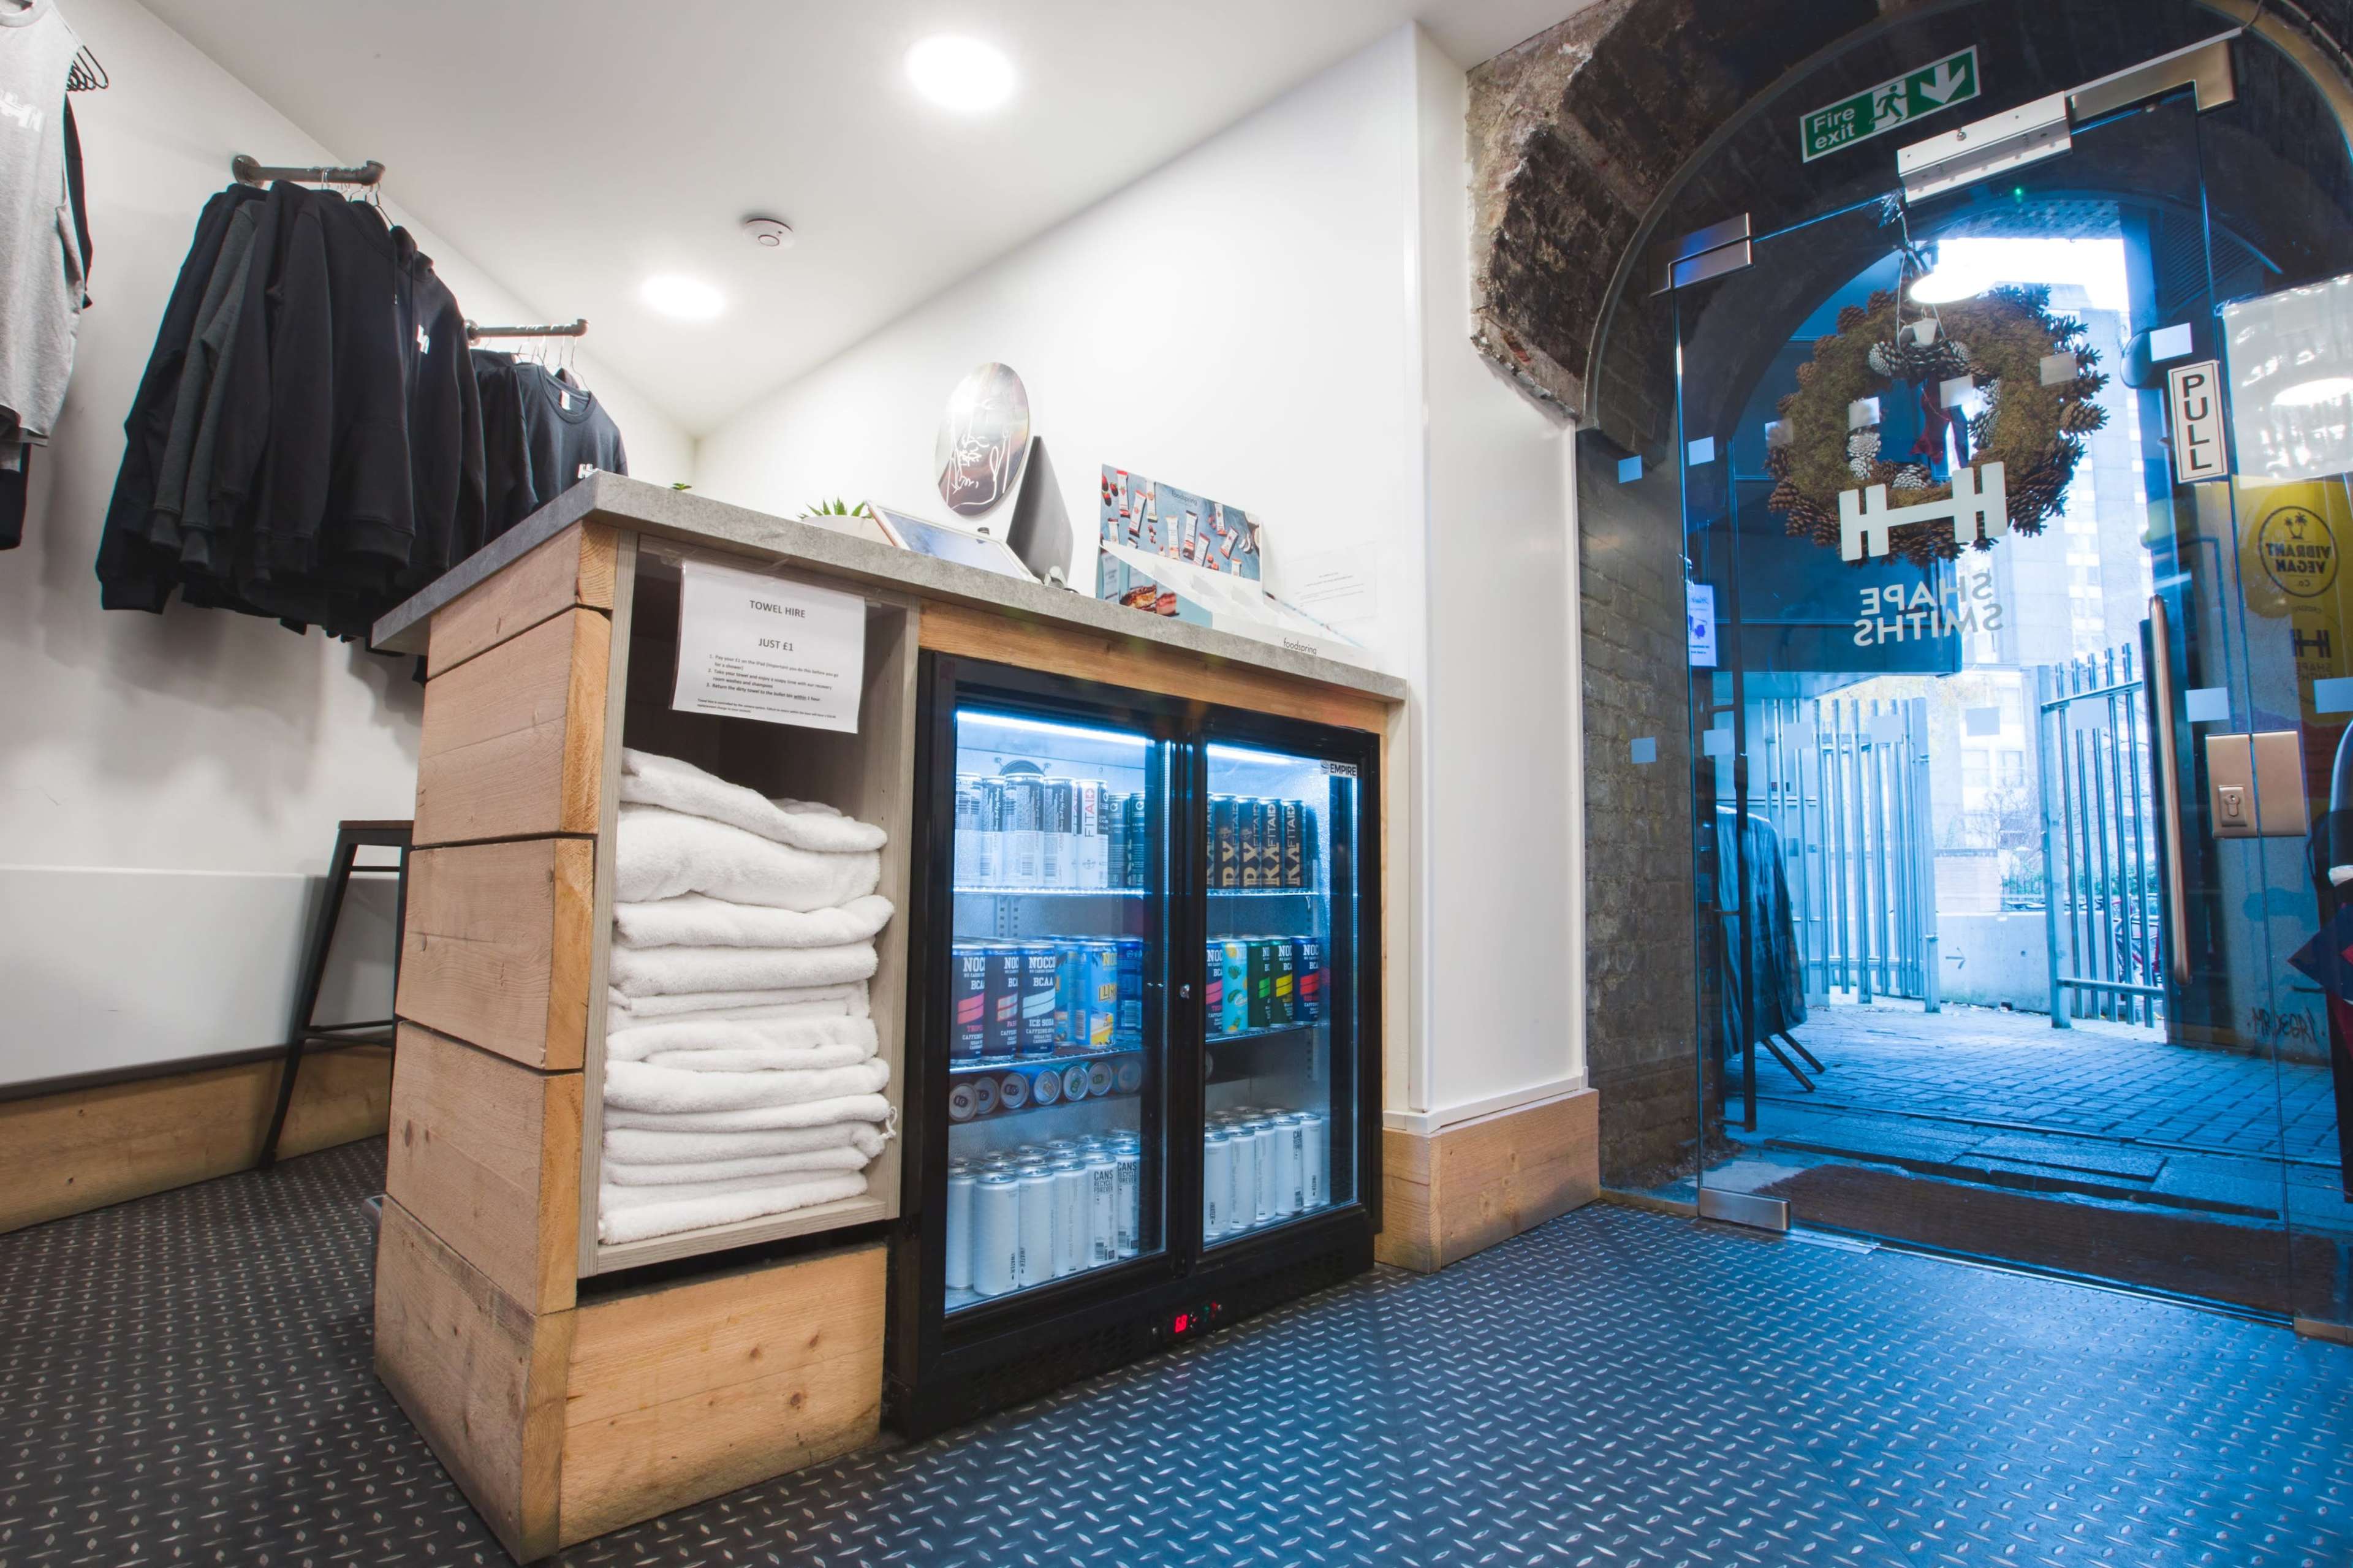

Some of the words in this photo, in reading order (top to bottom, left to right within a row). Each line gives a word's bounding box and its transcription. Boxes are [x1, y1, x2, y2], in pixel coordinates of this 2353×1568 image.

[1813, 106, 1855, 134] Fire
[1815, 123, 1854, 149] exit
[2182, 374, 2212, 471] PULL
[750, 600, 782, 615] TOWEL
[785, 607, 806, 618] HIRE
[758, 638, 781, 650] JUST
[783, 641, 794, 651] £1
[1283, 638, 1317, 655] foodspring
[1330, 763, 1356, 776] EMPIRE
[1033, 977, 1053, 987] BCAA
[1118, 1162, 1137, 1171] CANS
[1094, 1170, 1113, 1181] CANS
